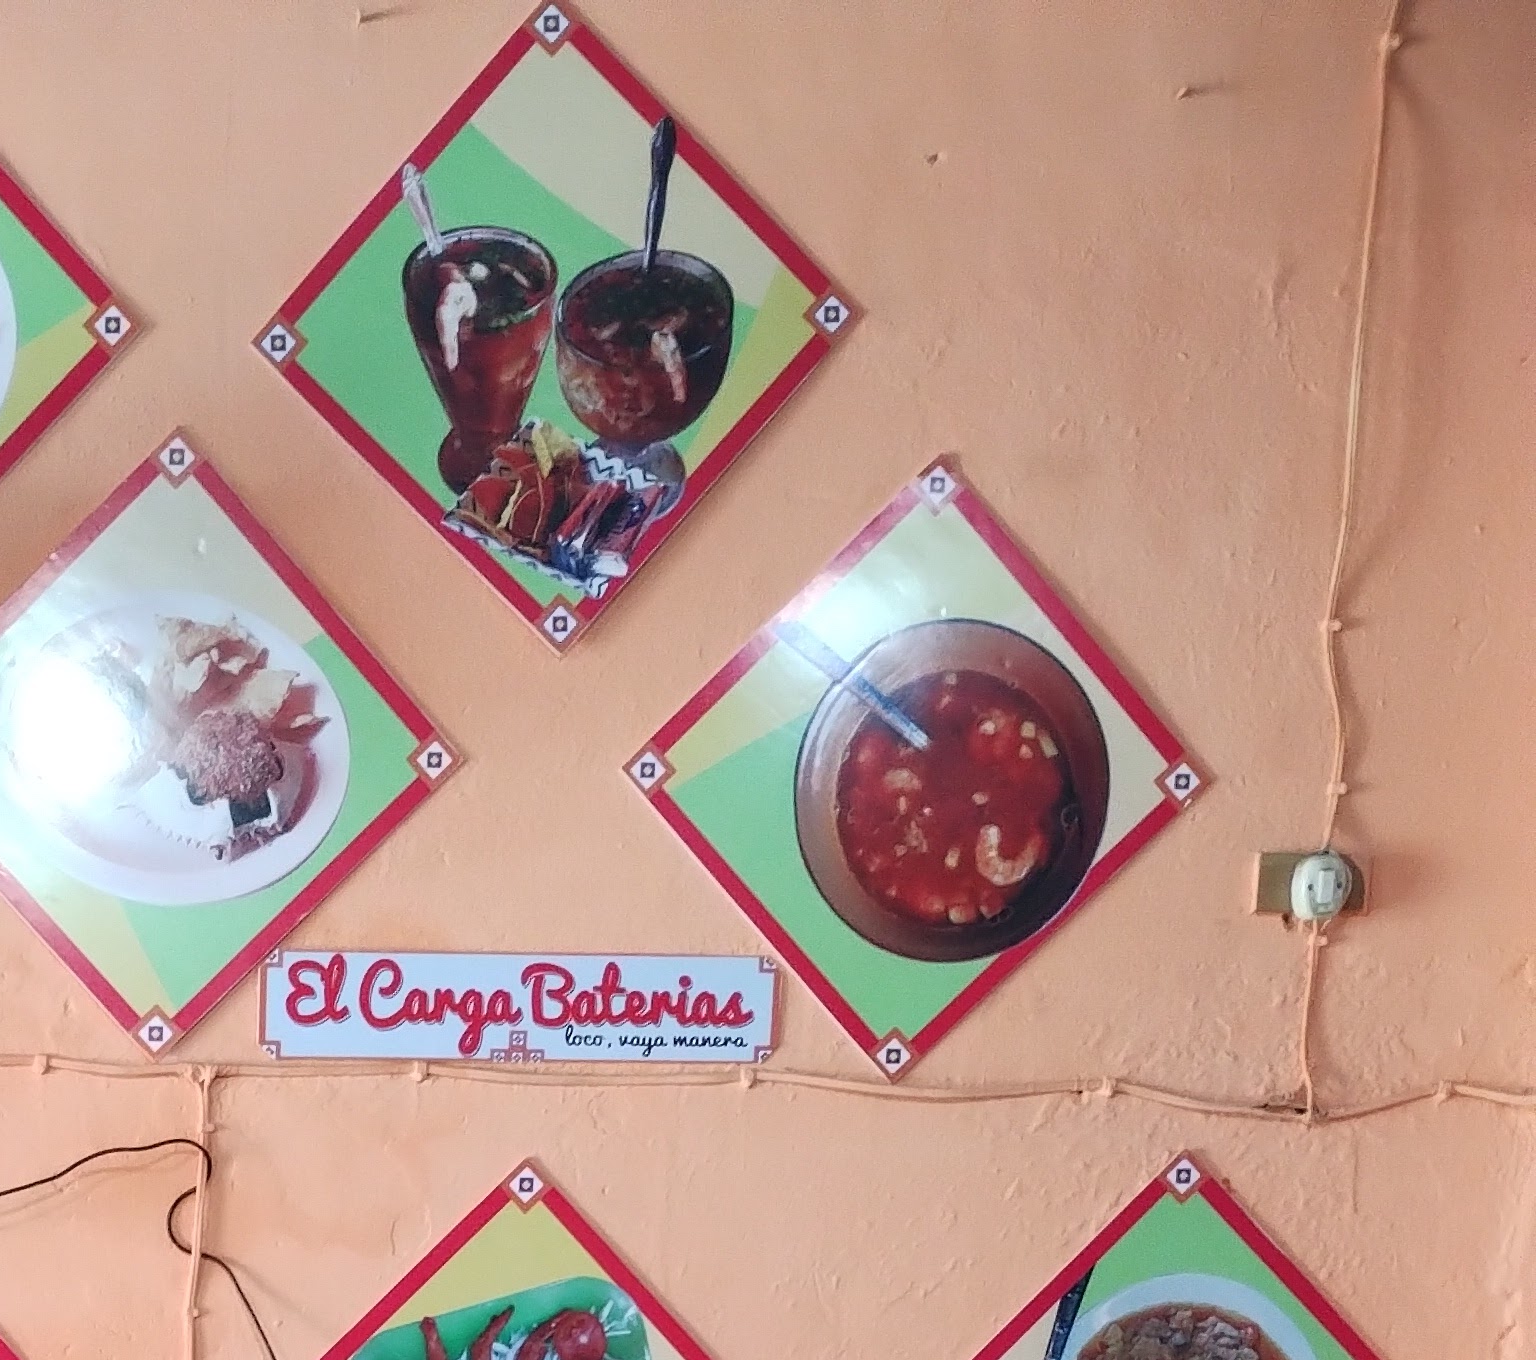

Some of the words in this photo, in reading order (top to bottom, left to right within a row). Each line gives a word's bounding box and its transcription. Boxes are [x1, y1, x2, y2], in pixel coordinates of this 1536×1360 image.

[286, 953, 351, 1026] El
[359, 958, 523, 1058] Carga
[521, 961, 754, 1029] Baterias
[618, 1034, 668, 1058] vaya
[672, 1033, 749, 1048] manera
